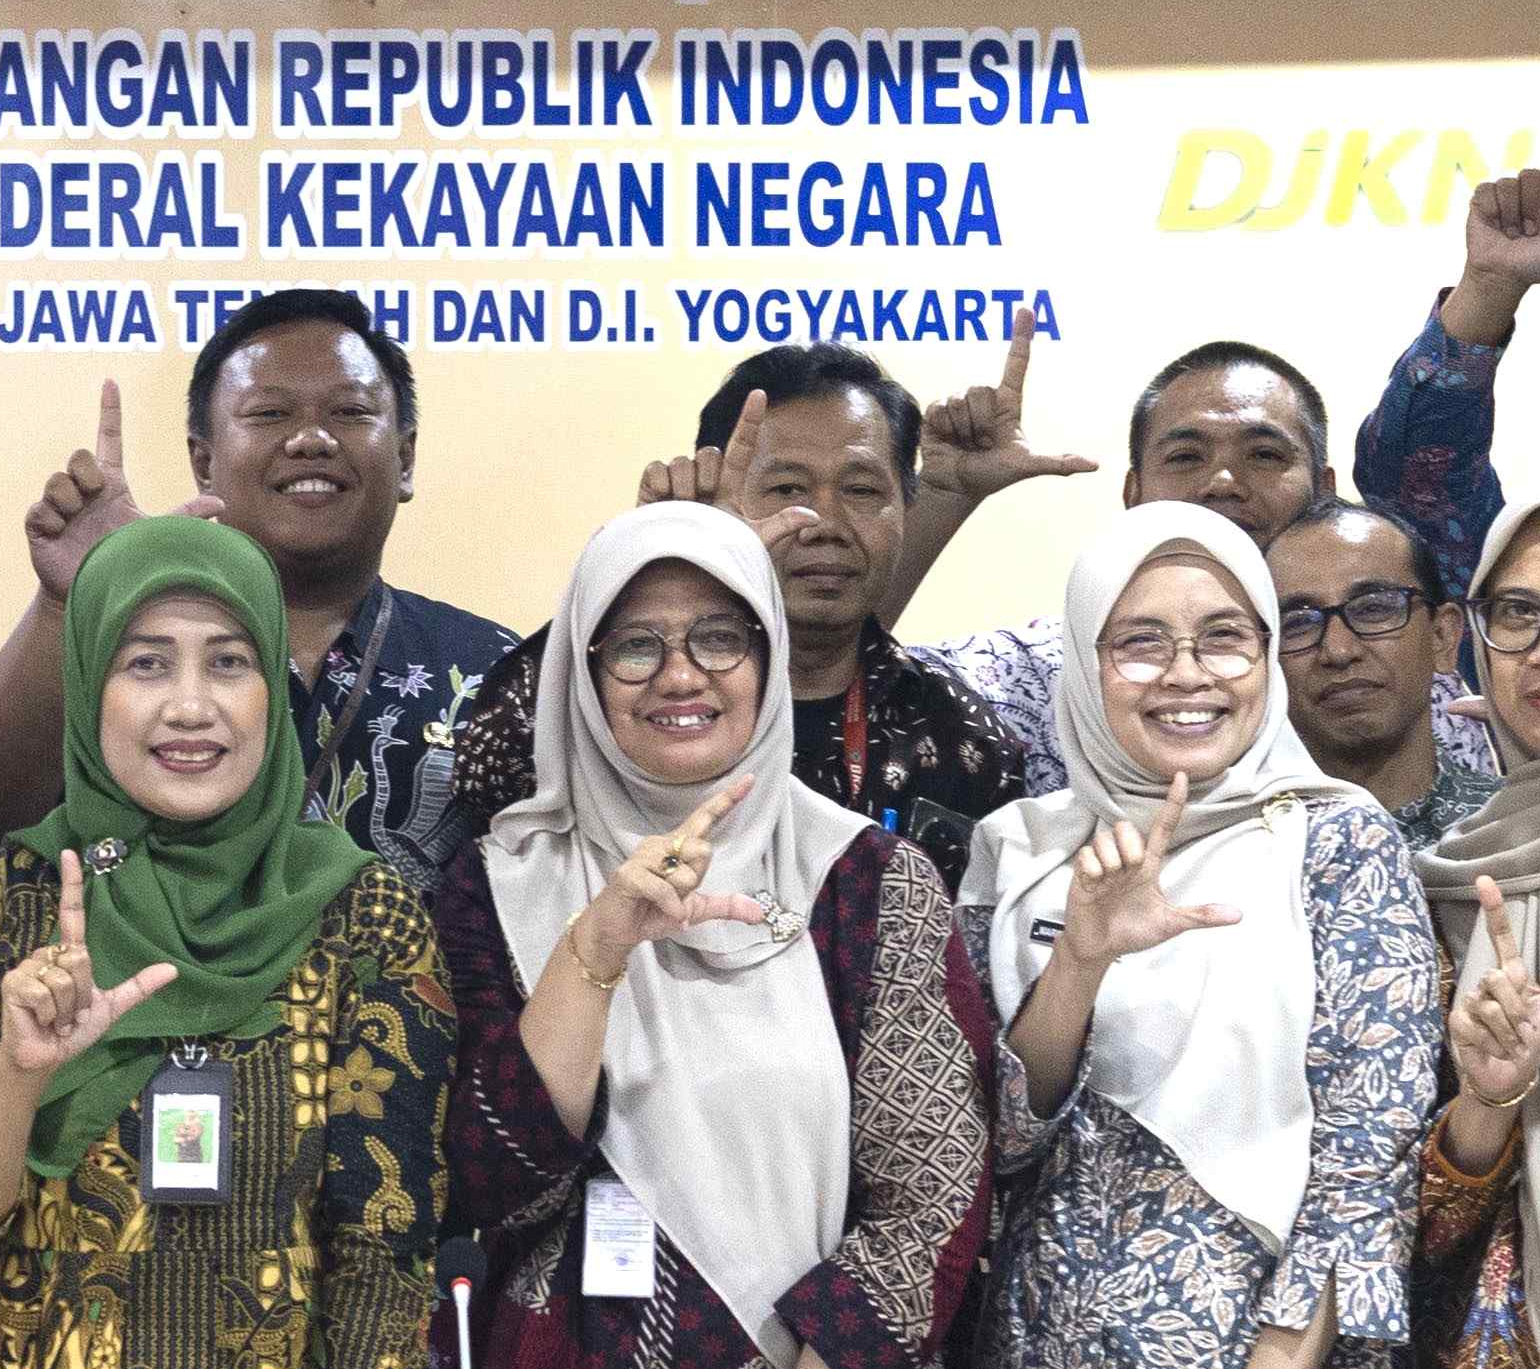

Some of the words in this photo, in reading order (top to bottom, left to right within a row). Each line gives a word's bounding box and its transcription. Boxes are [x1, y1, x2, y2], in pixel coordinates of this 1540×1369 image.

[279, 41, 652, 127] REPUBLIK
[680, 39, 1089, 127] INDONESIA
[267, 162, 665, 248] KEKAYAAN
[696, 160, 1002, 247] NEGARA
[175, 289, 409, 344] TEH
[433, 289, 545, 343] DAN
[569, 289, 654, 343] D.I.
[675, 288, 1061, 344] YOGYAKARTA
